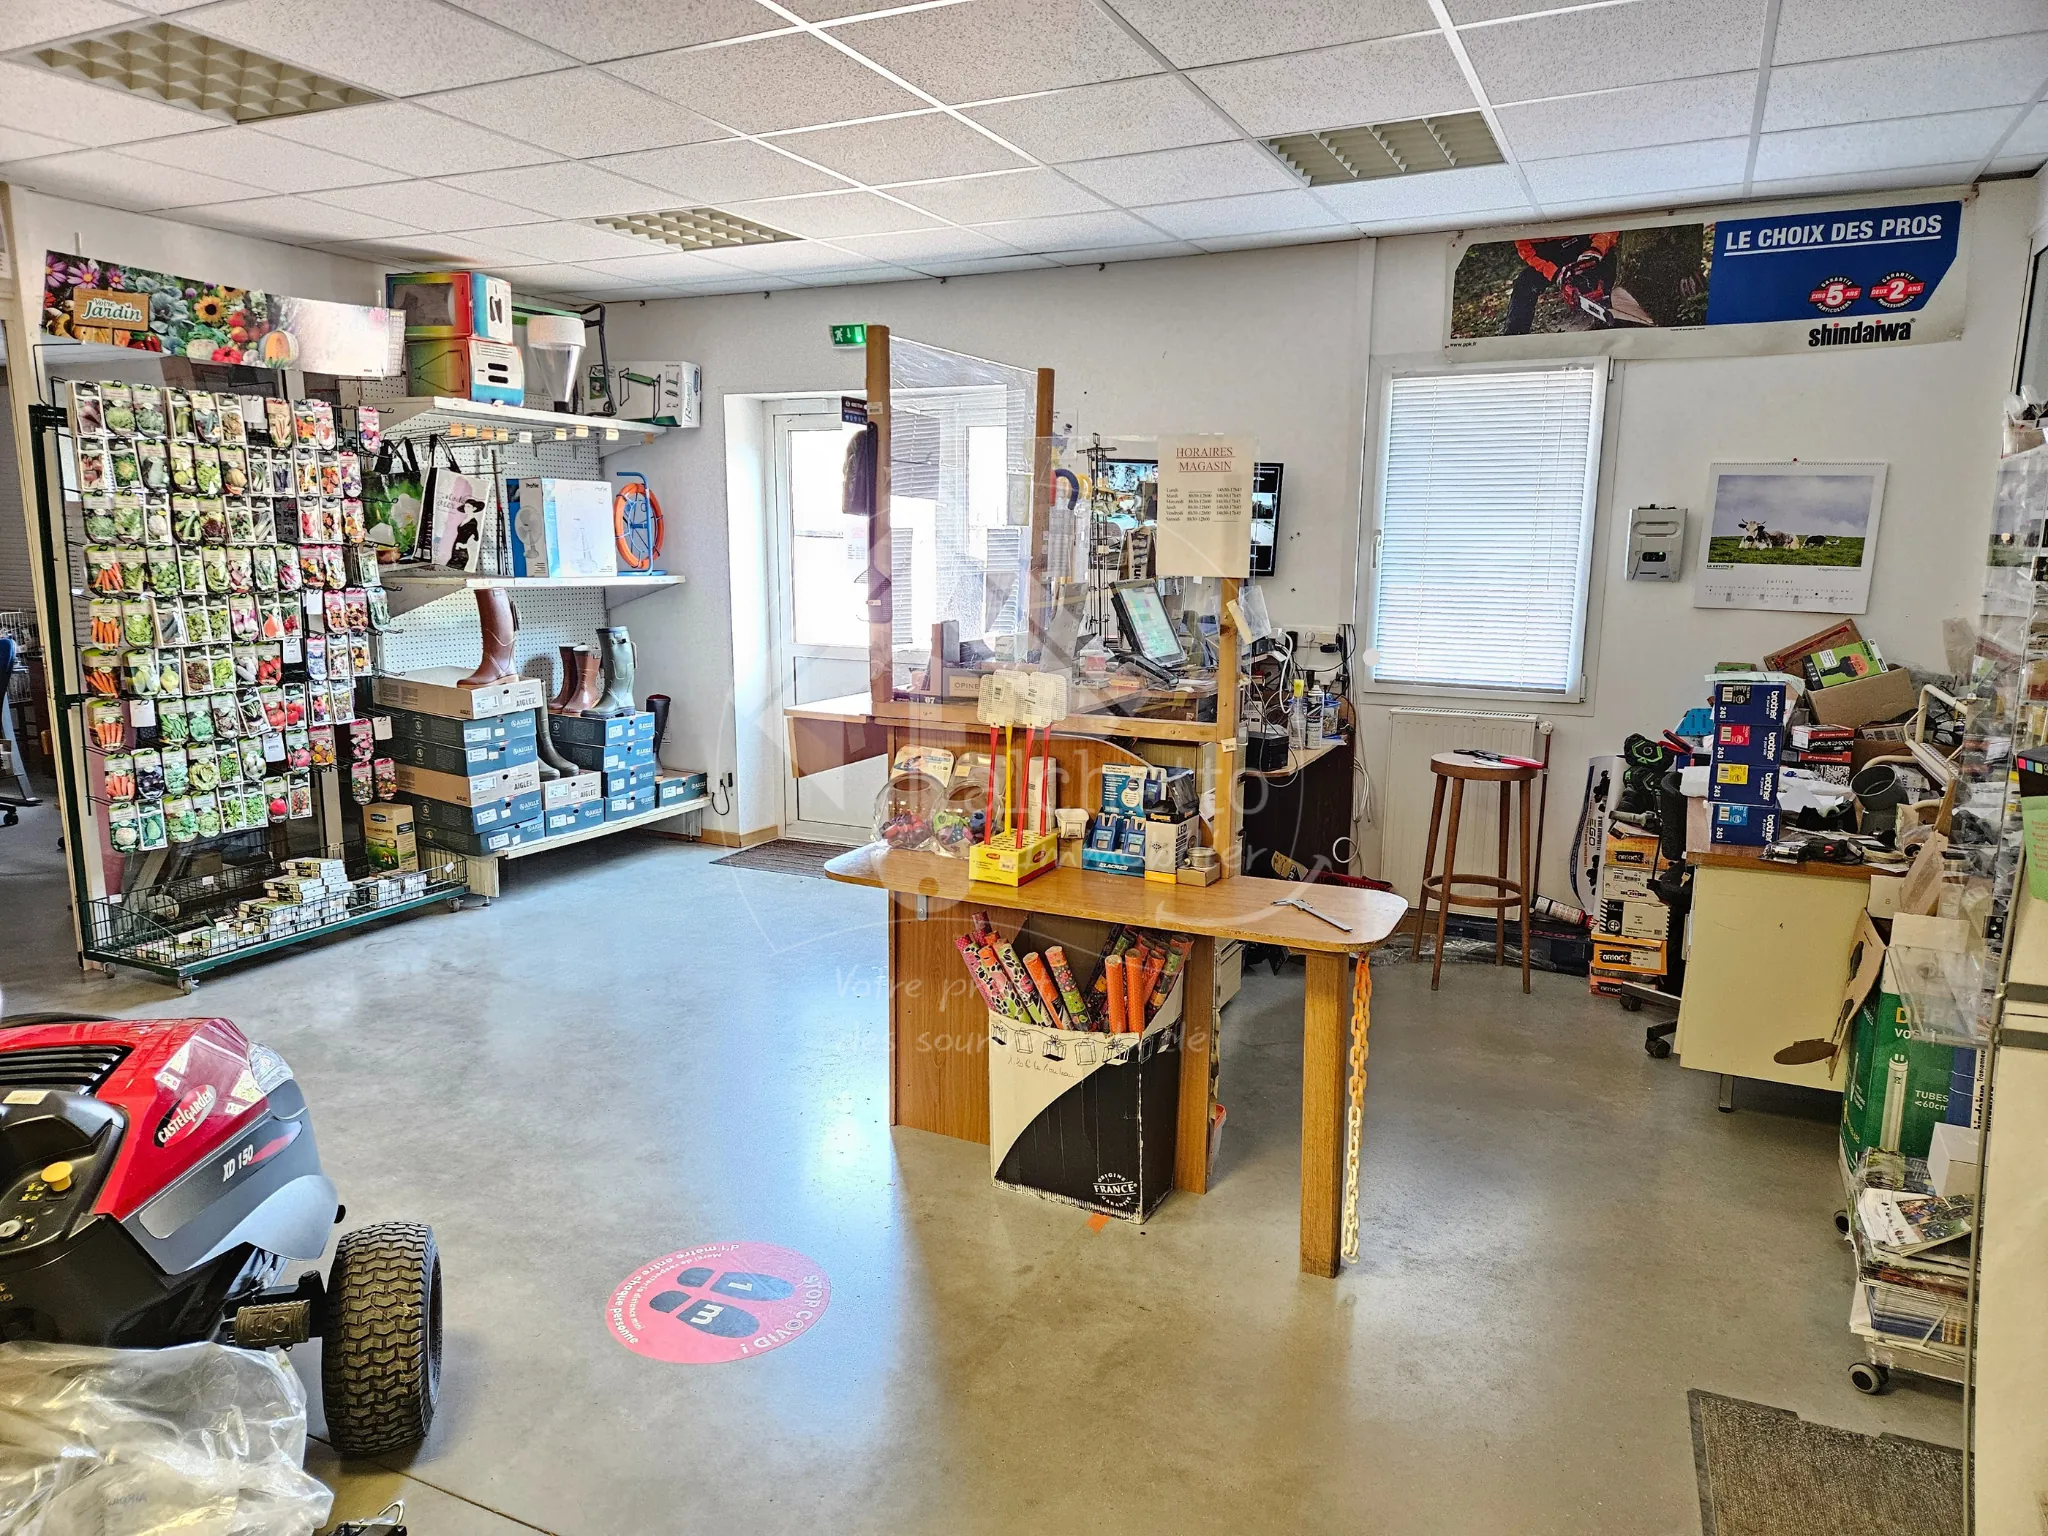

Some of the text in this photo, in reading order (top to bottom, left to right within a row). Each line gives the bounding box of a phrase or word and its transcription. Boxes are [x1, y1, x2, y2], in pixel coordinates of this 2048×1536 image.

[1726, 214, 1942, 251] LE CHOIX DES PROS
[1825, 284, 1844, 306] 5
[1889, 280, 1905, 300] 2
[81, 300, 143, 322] Jardin
[1808, 319, 1912, 347] shindaiwa
[1176, 447, 1234, 458] HORAIRES
[1179, 461, 1232, 472] MAGASIN
[955, 682, 980, 690] OPINE
[1769, 690, 1779, 720] brother
[1766, 732, 1777, 761] brother
[1713, 785, 1721, 797] 243
[1763, 772, 1774, 801] brother
[1177, 824, 1187, 836] LED
[1588, 819, 1597, 846] EGO
[1716, 827, 1724, 839] 243
[1765, 814, 1775, 842] brother
[1915, 1090, 1949, 1102] TUBES
[223, 1144, 254, 1183] XD 150
[1093, 1183, 1134, 1194] FRANCE
[1097, 1172, 1126, 1183] ORIGINE
[641, 1257, 673, 1277] entre
[614, 1275, 642, 1306] chaque
[803, 1274, 823, 1309] STOP
[609, 1307, 639, 1344] personne
[752, 1310, 813, 1348] COVID
